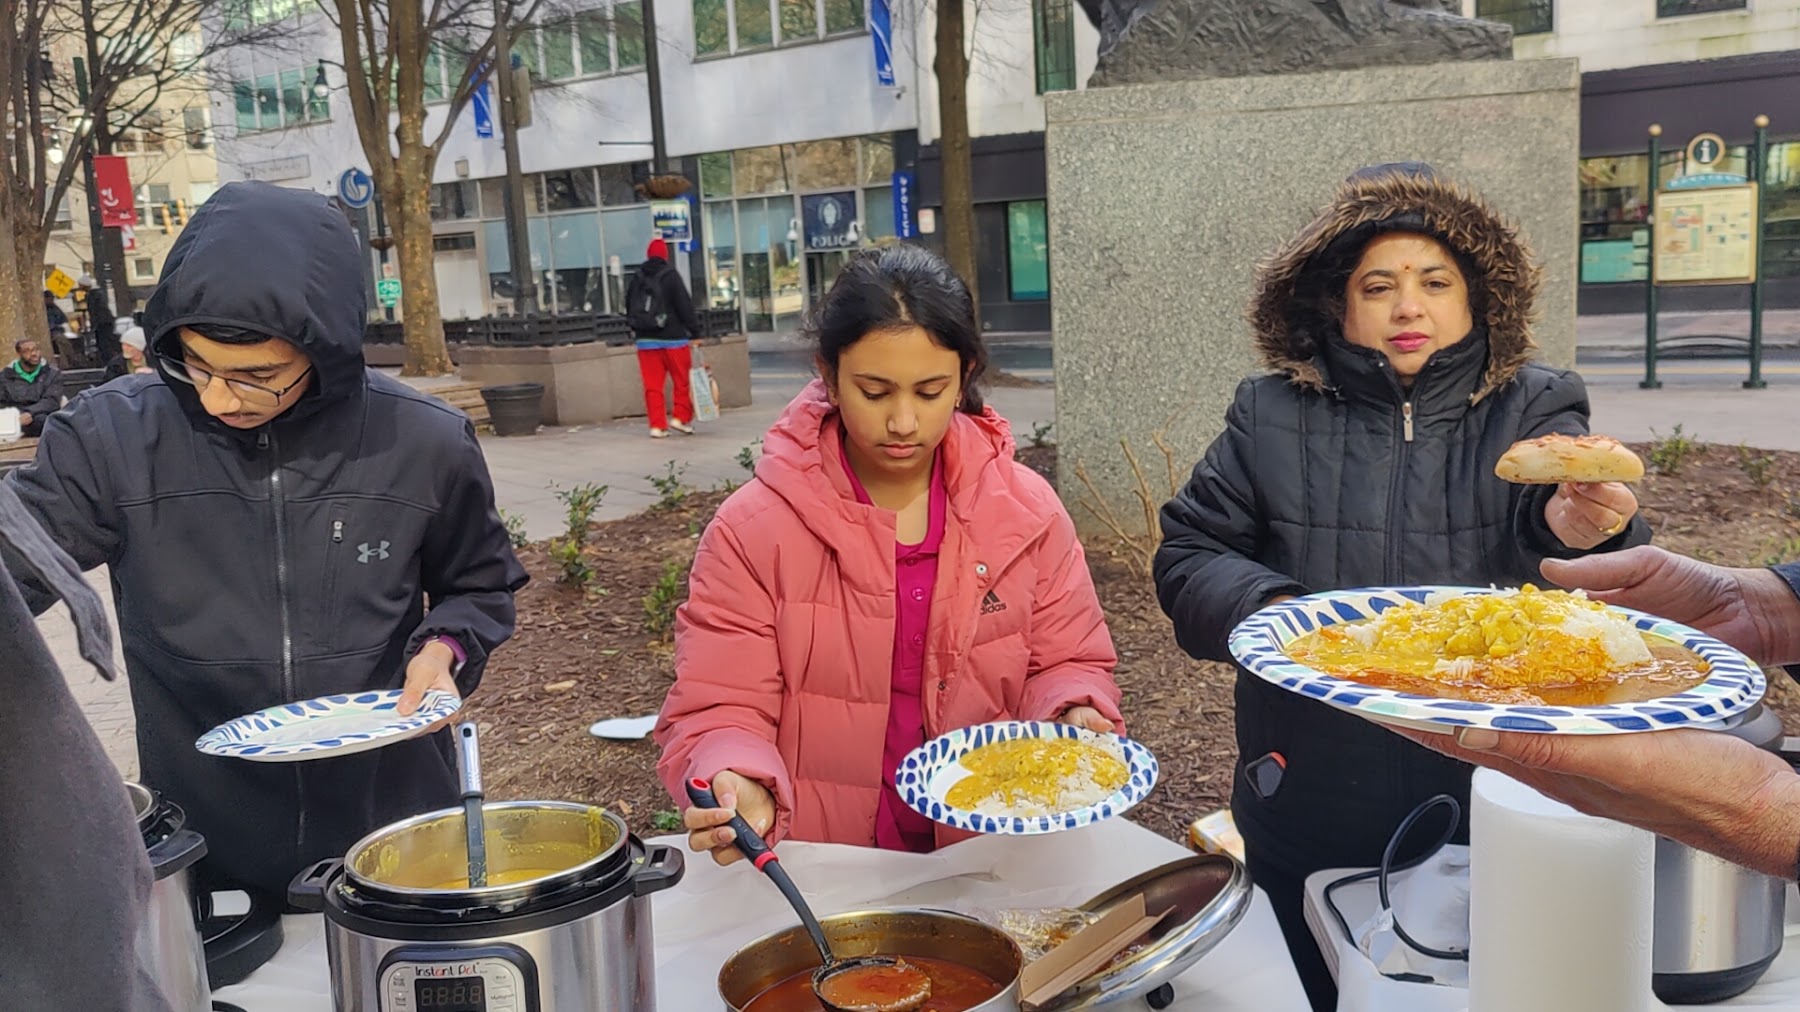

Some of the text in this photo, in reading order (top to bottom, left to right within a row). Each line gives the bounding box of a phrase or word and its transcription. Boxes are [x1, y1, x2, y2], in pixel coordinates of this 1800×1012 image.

[811, 234, 854, 248] POLIC
[980, 602, 1007, 615] didas
[415, 963, 478, 977] Instant Pot
